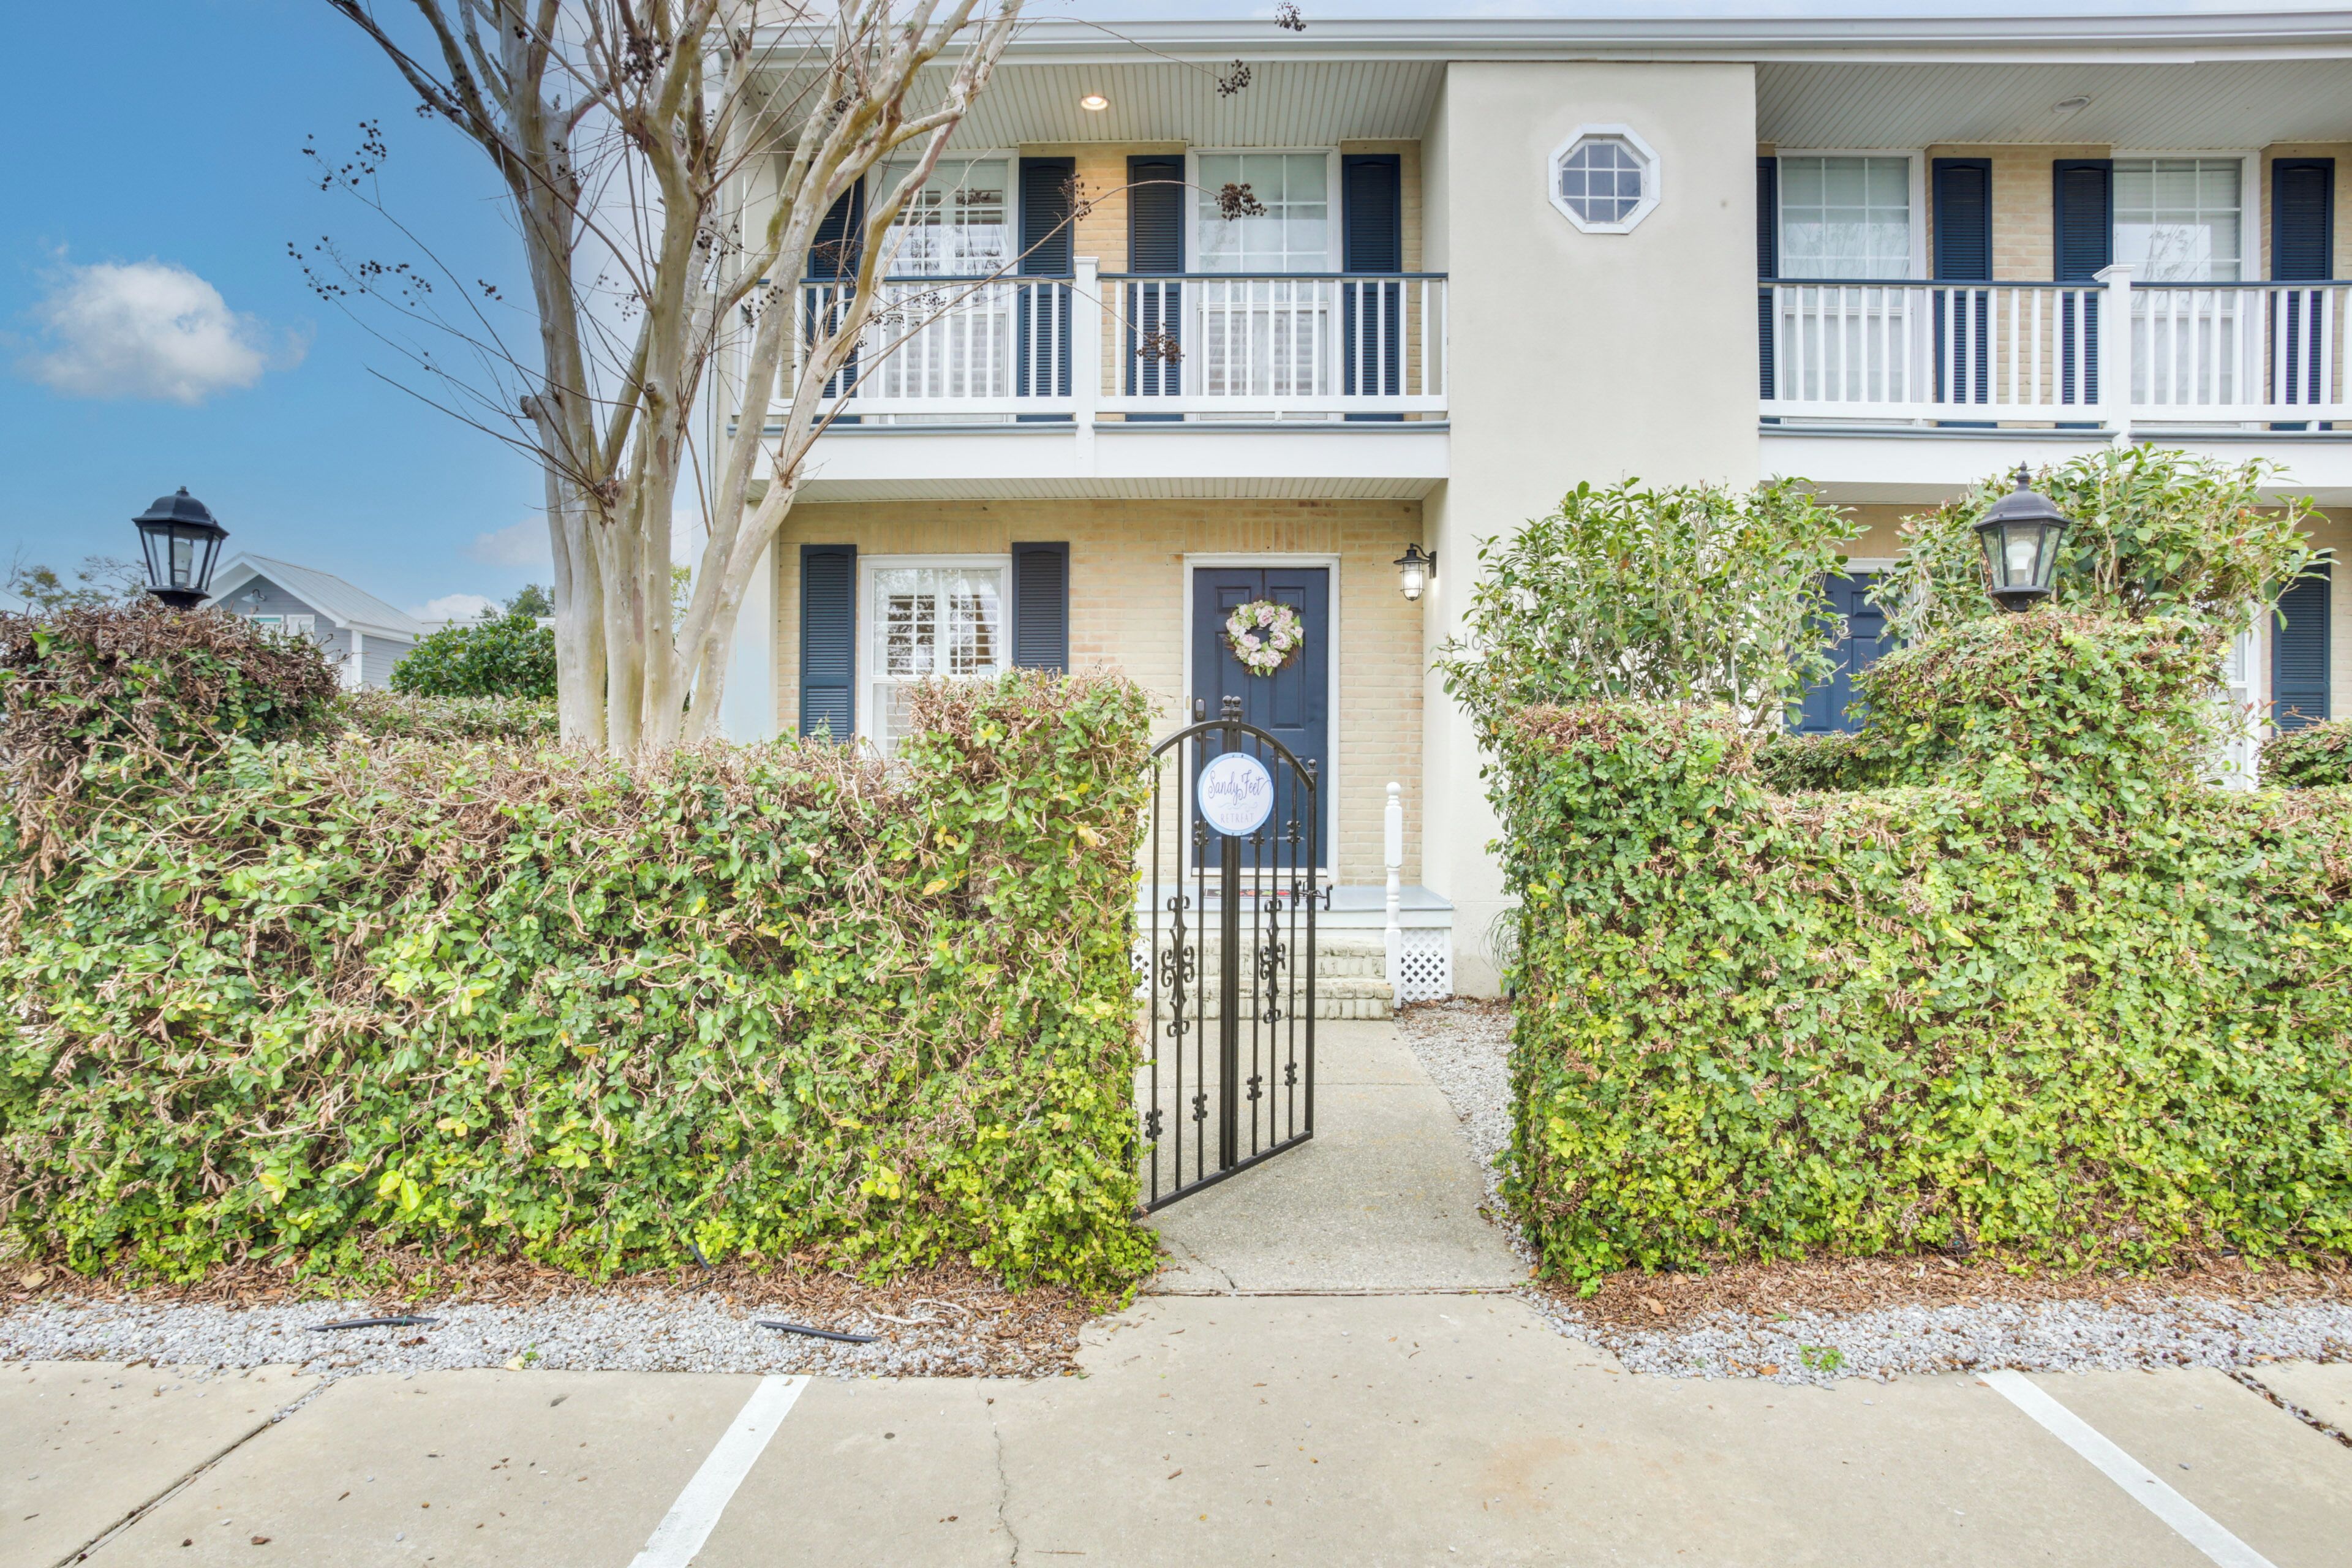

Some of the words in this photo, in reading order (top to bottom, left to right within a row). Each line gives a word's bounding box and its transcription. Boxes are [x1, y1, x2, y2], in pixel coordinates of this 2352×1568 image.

[1208, 770, 1243, 805] Sandy
[1242, 769, 1272, 799] Feet
[1221, 813, 1254, 824] RETREAT
